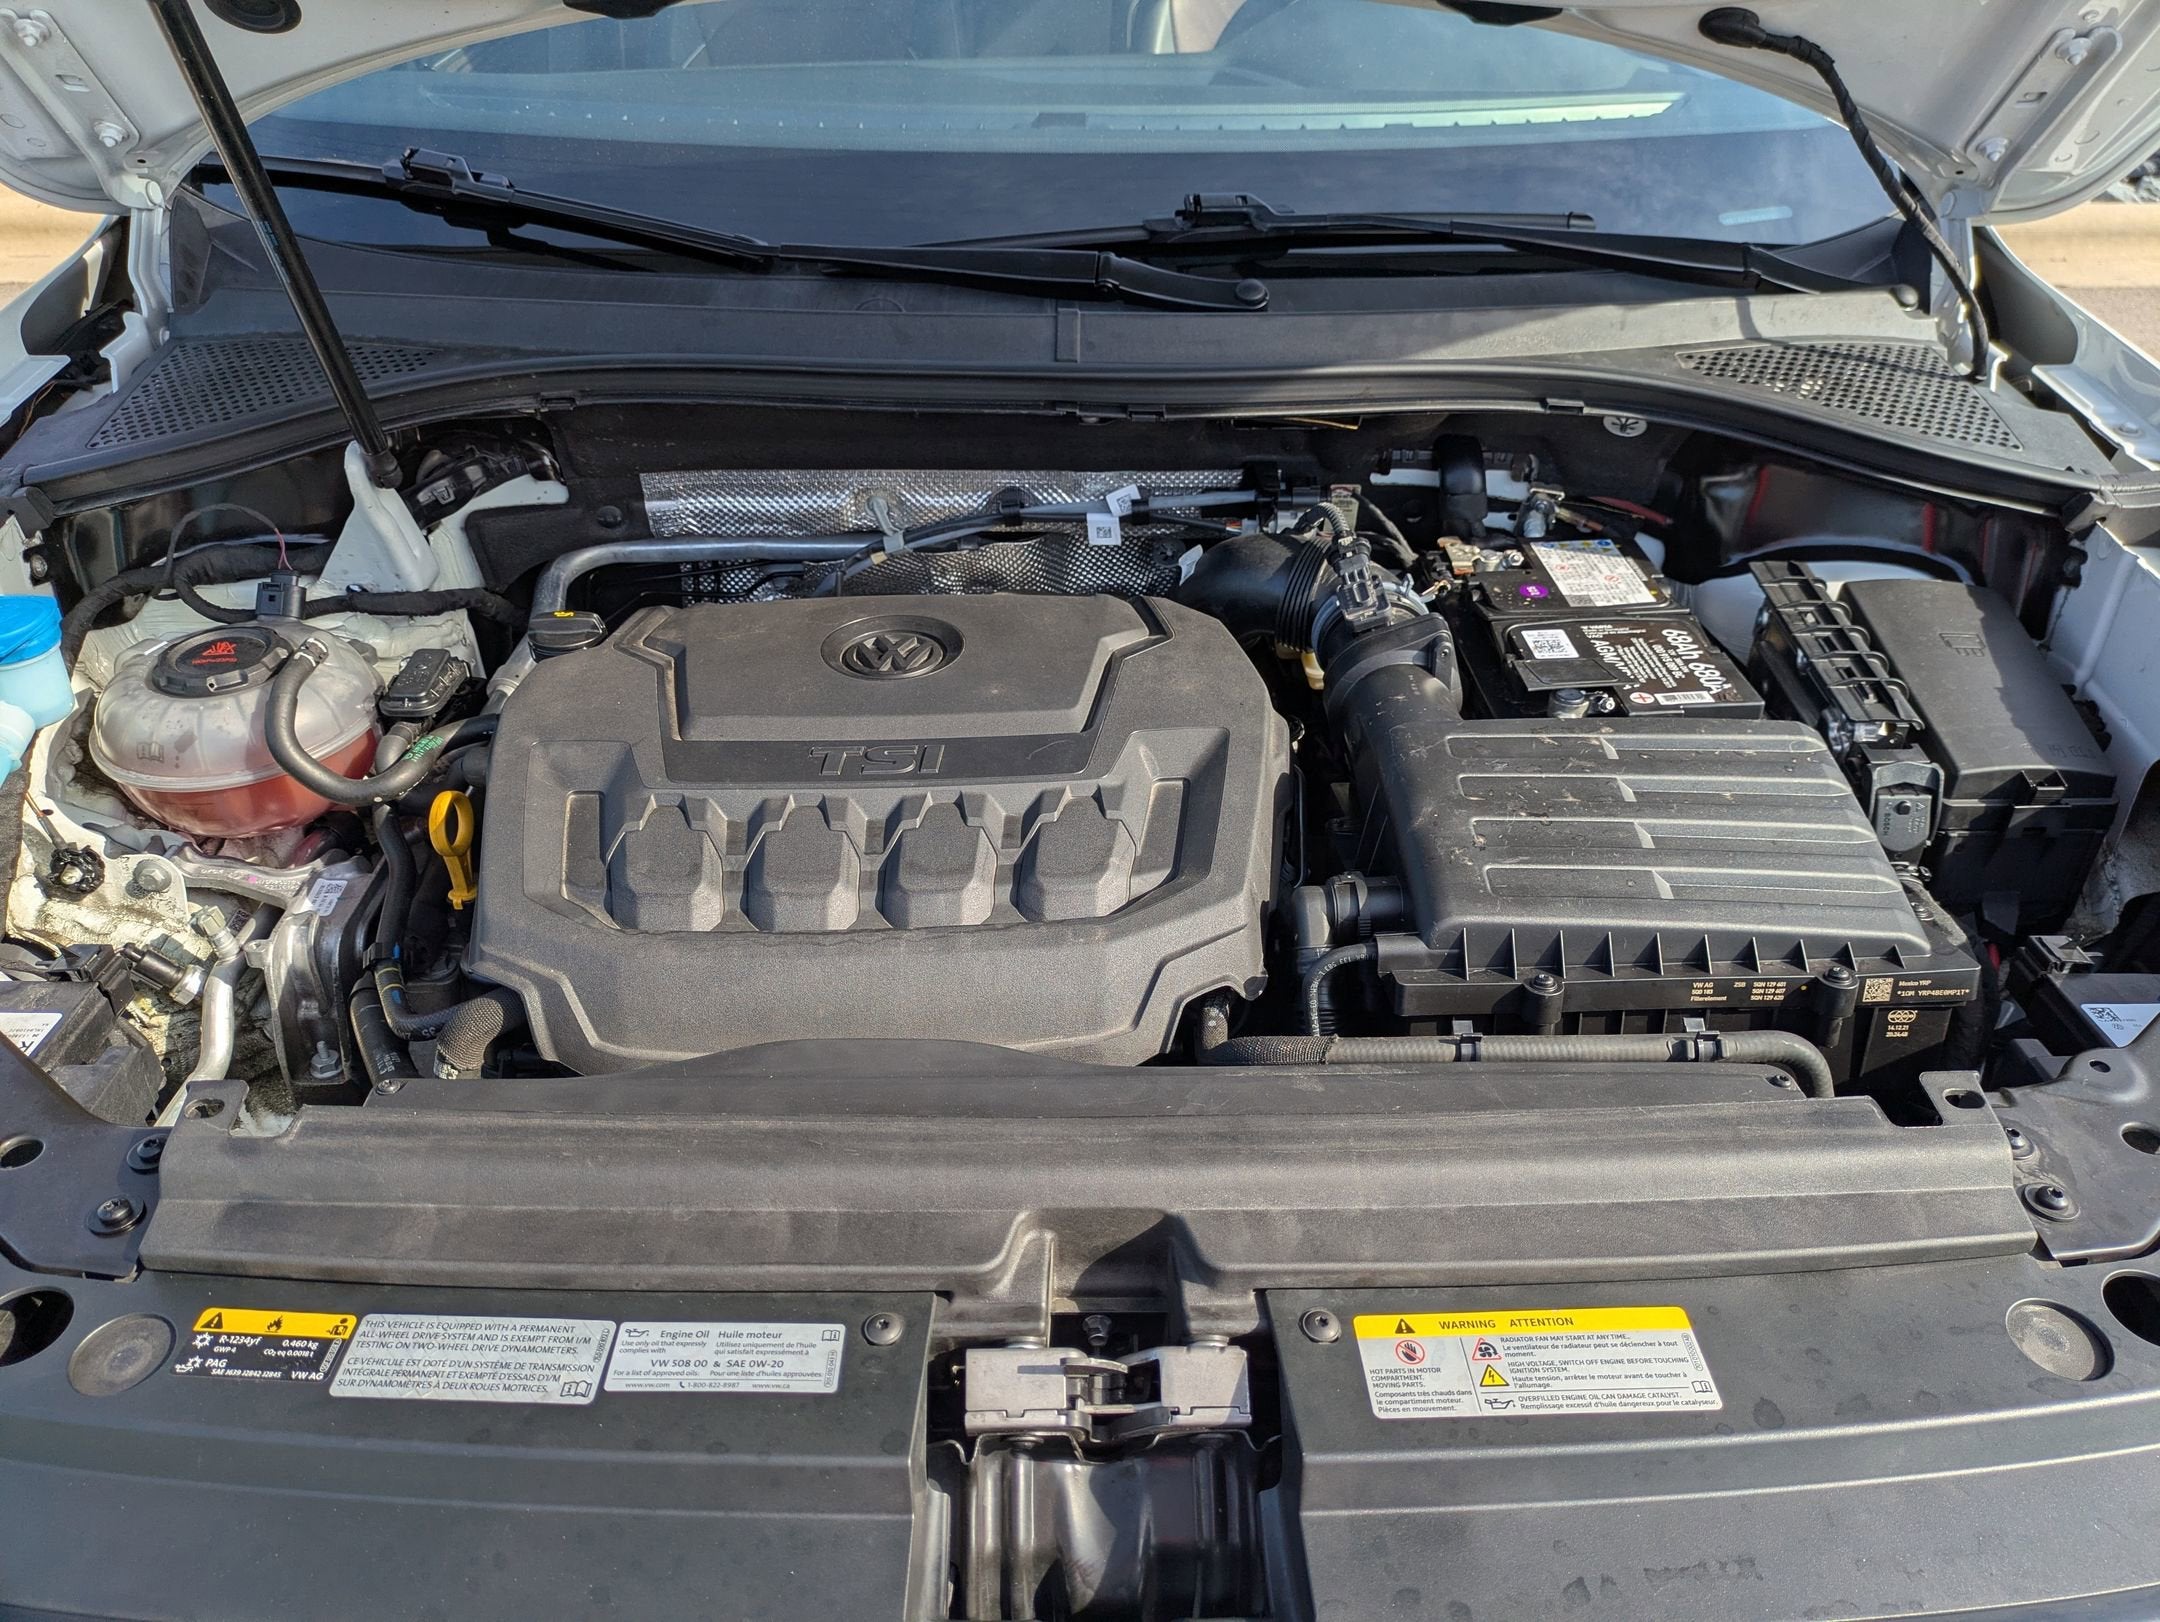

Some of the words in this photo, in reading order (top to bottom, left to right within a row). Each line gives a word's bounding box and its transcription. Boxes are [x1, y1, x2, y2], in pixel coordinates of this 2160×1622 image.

[1662, 629, 1703, 659] 68Ah
[847, 632, 938, 675] VW
[808, 744, 945, 776] TSI
[366, 1320, 385, 1328] THIS
[387, 1321, 425, 1329] VEHICLE
[436, 1322, 482, 1331] EQUIPPED
[484, 1323, 509, 1331] WITH
[520, 1325, 576, 1333] PERMANENT
[1440, 1320, 1496, 1330] WARNING
[1510, 1317, 1574, 1328] ATTENTION
[360, 1331, 410, 1339] ALL-WHEEL
[412, 1332, 440, 1340] DRIVE
[441, 1332, 476, 1340] SYSTEM
[548, 1336, 574, 1344] FROM
[660, 1330, 693, 1340] Engine
[696, 1330, 710, 1338] Oil
[718, 1331, 743, 1339] Huile
[219, 1335, 263, 1347] R-1234yf
[308, 1340, 319, 1350] kg
[356, 1340, 394, 1349] TESTING
[395, 1341, 411, 1349] ON
[412, 1342, 470, 1351] TWO-WHEEL
[472, 1344, 500, 1352] DRIVE
[501, 1345, 578, 1354] DYNAMOMETERS.
[205, 1359, 228, 1368] PAG
[347, 1357, 359, 1365] CE
[513, 1362, 526, 1370] DE
[528, 1362, 594, 1372] TRANSMISSION
[726, 1360, 746, 1368] SAE
[749, 1360, 784, 1368] 0W-20
[291, 1371, 308, 1380] VW
[308, 1372, 324, 1380] AG
[391, 1370, 446, 1378] PERMANENT
[442, 1381, 471, 1390] DEUX
[471, 1383, 500, 1391] ROUES
[1375, 1391, 1416, 1399] Composants
[1384, 1398, 1435, 1406] compartiment
